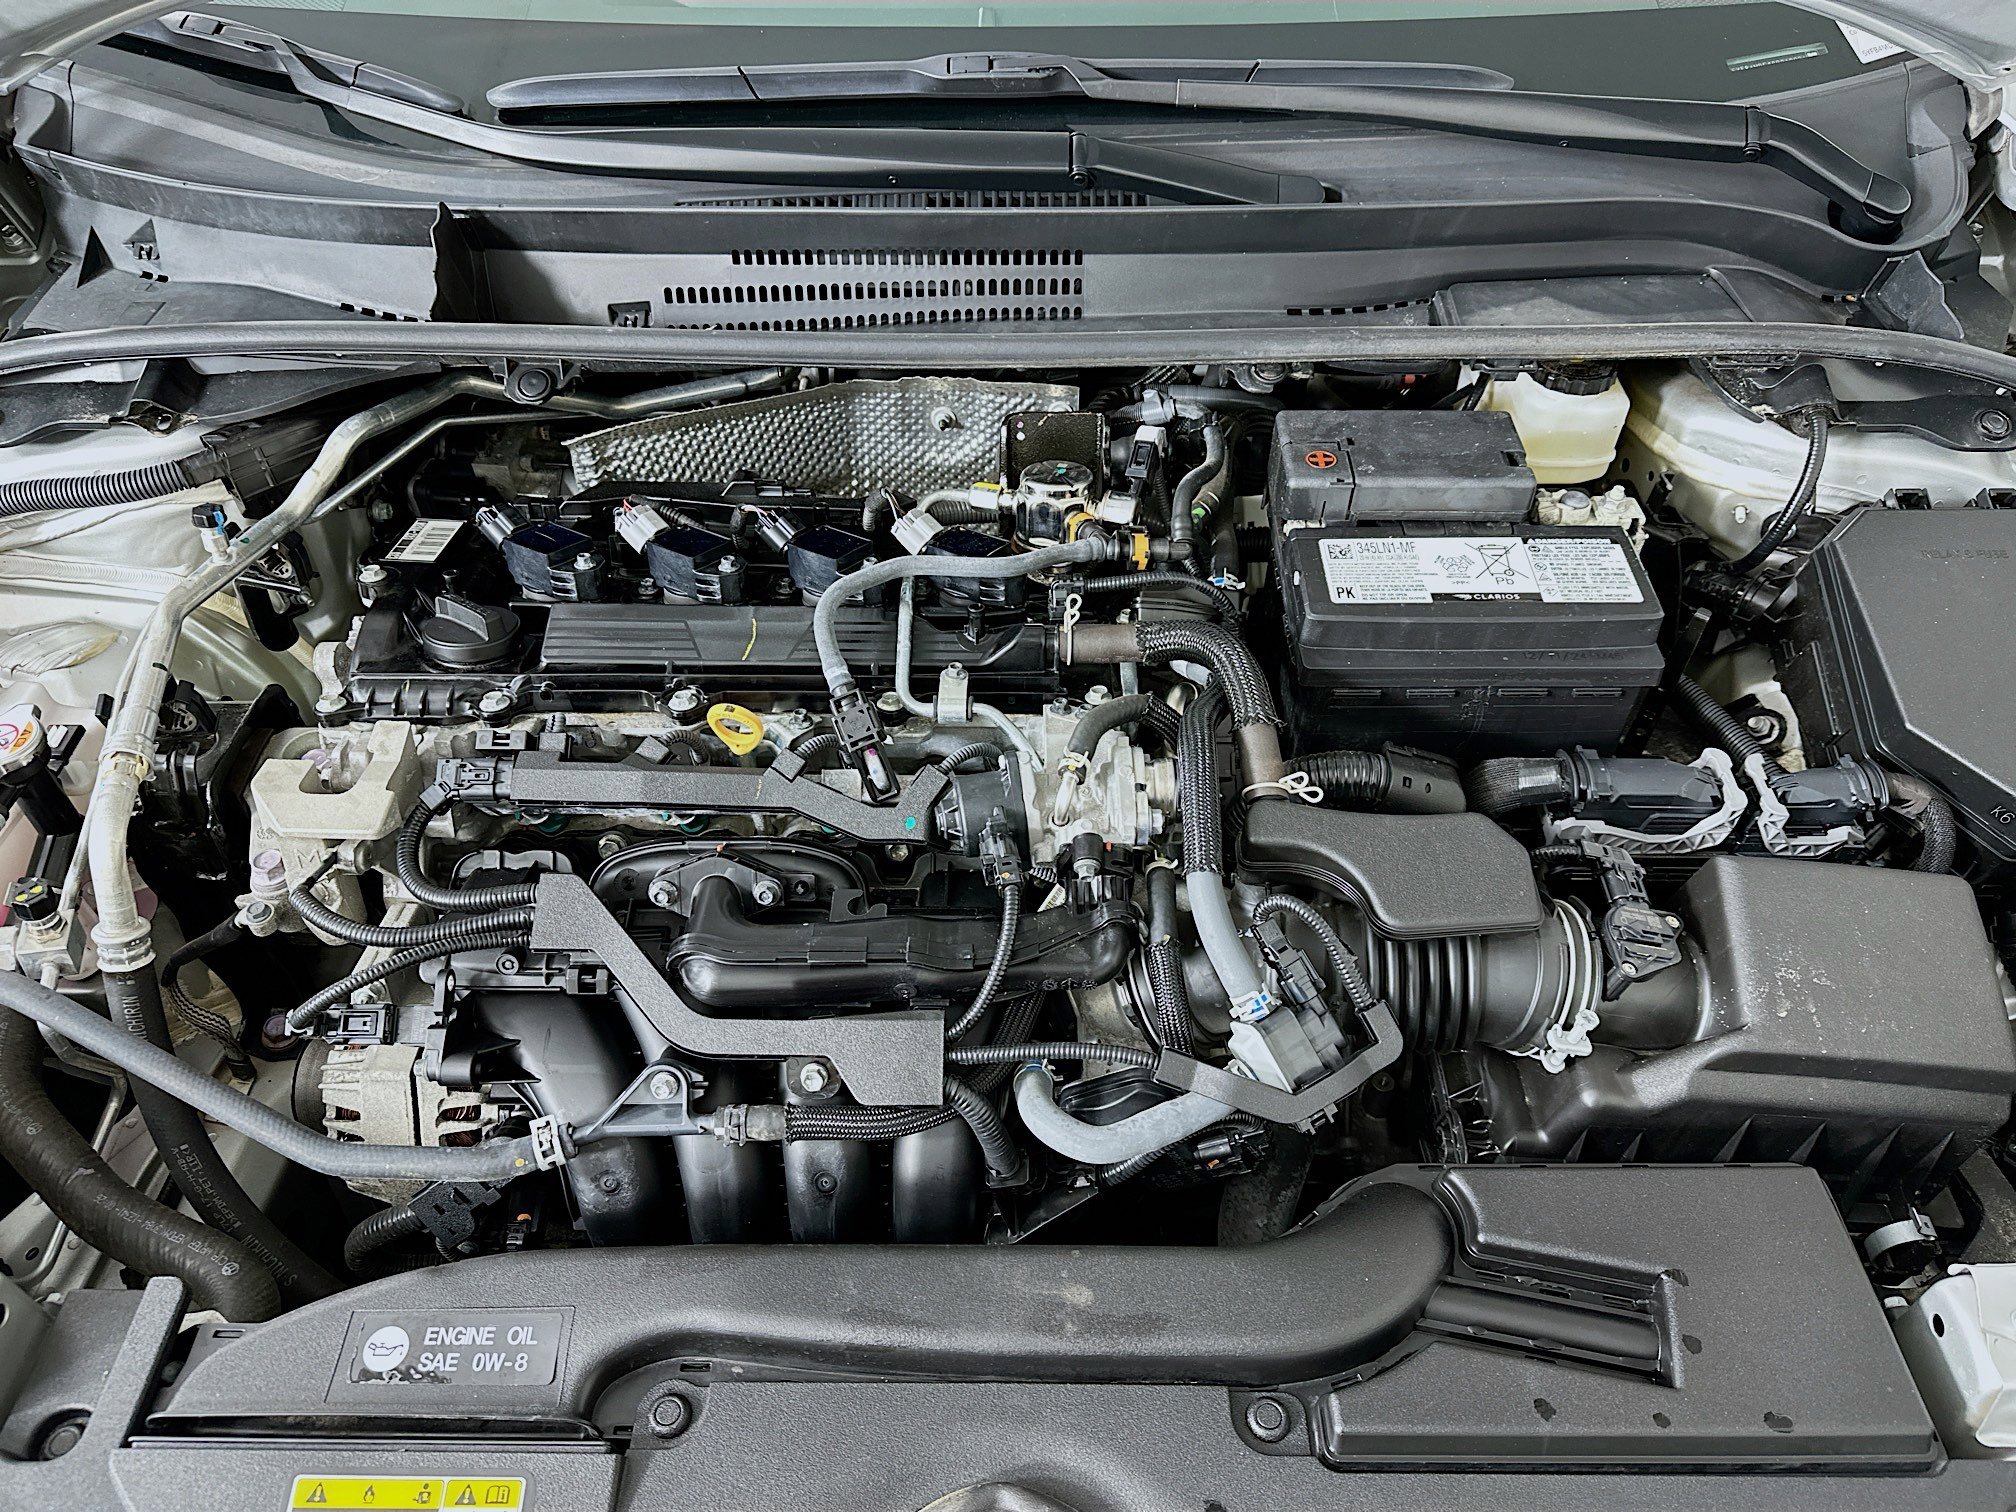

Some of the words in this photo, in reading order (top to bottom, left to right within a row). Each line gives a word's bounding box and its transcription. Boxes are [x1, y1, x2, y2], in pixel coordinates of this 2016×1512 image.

[1356, 541, 1416, 554] 345LN1-MF
[1336, 587, 1355, 599] PK
[1990, 805, 2015, 824] K6
[423, 1326, 495, 1346] ENGINE
[506, 1326, 538, 1346] OIL
[417, 1352, 460, 1373] SAE
[472, 1352, 528, 1372] 0W-8
